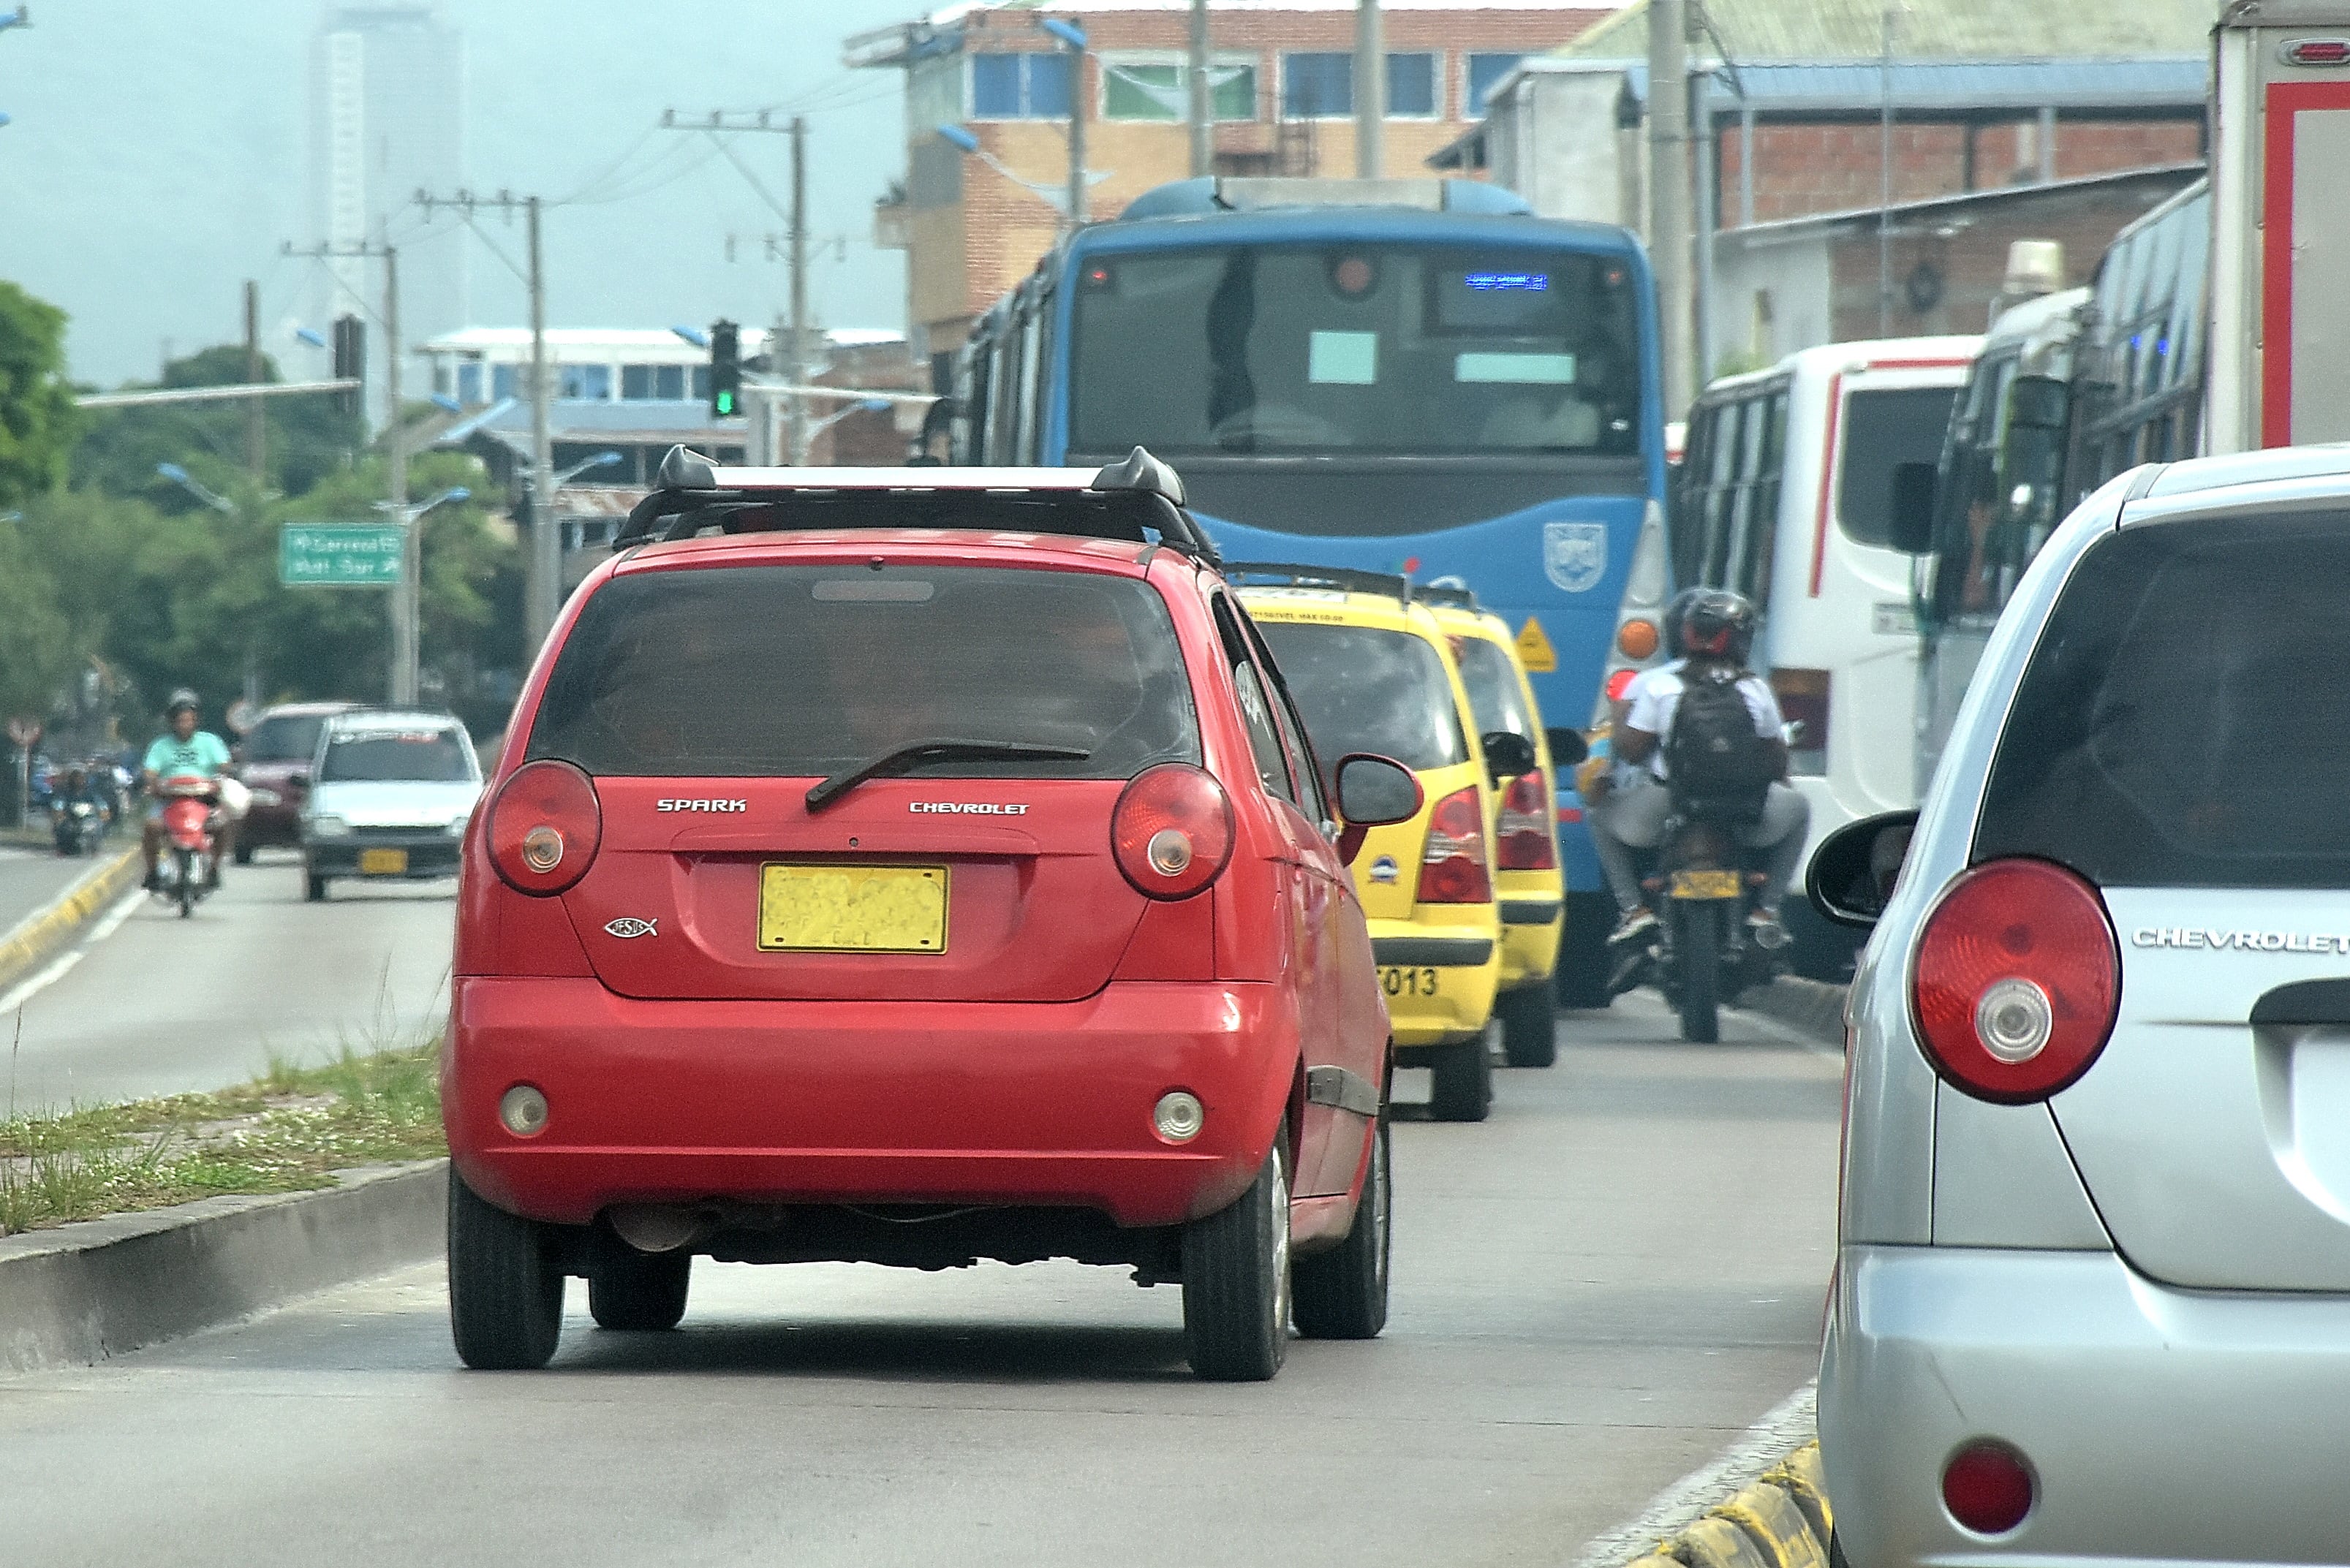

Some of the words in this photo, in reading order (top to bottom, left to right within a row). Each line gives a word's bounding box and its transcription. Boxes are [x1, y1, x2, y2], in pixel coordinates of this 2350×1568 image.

[657, 798, 747, 813] SPARK
[909, 801, 1030, 815] CHEVROLET
[611, 920, 644, 935] JESUS
[2131, 926, 2350, 954] CHEVROLET
